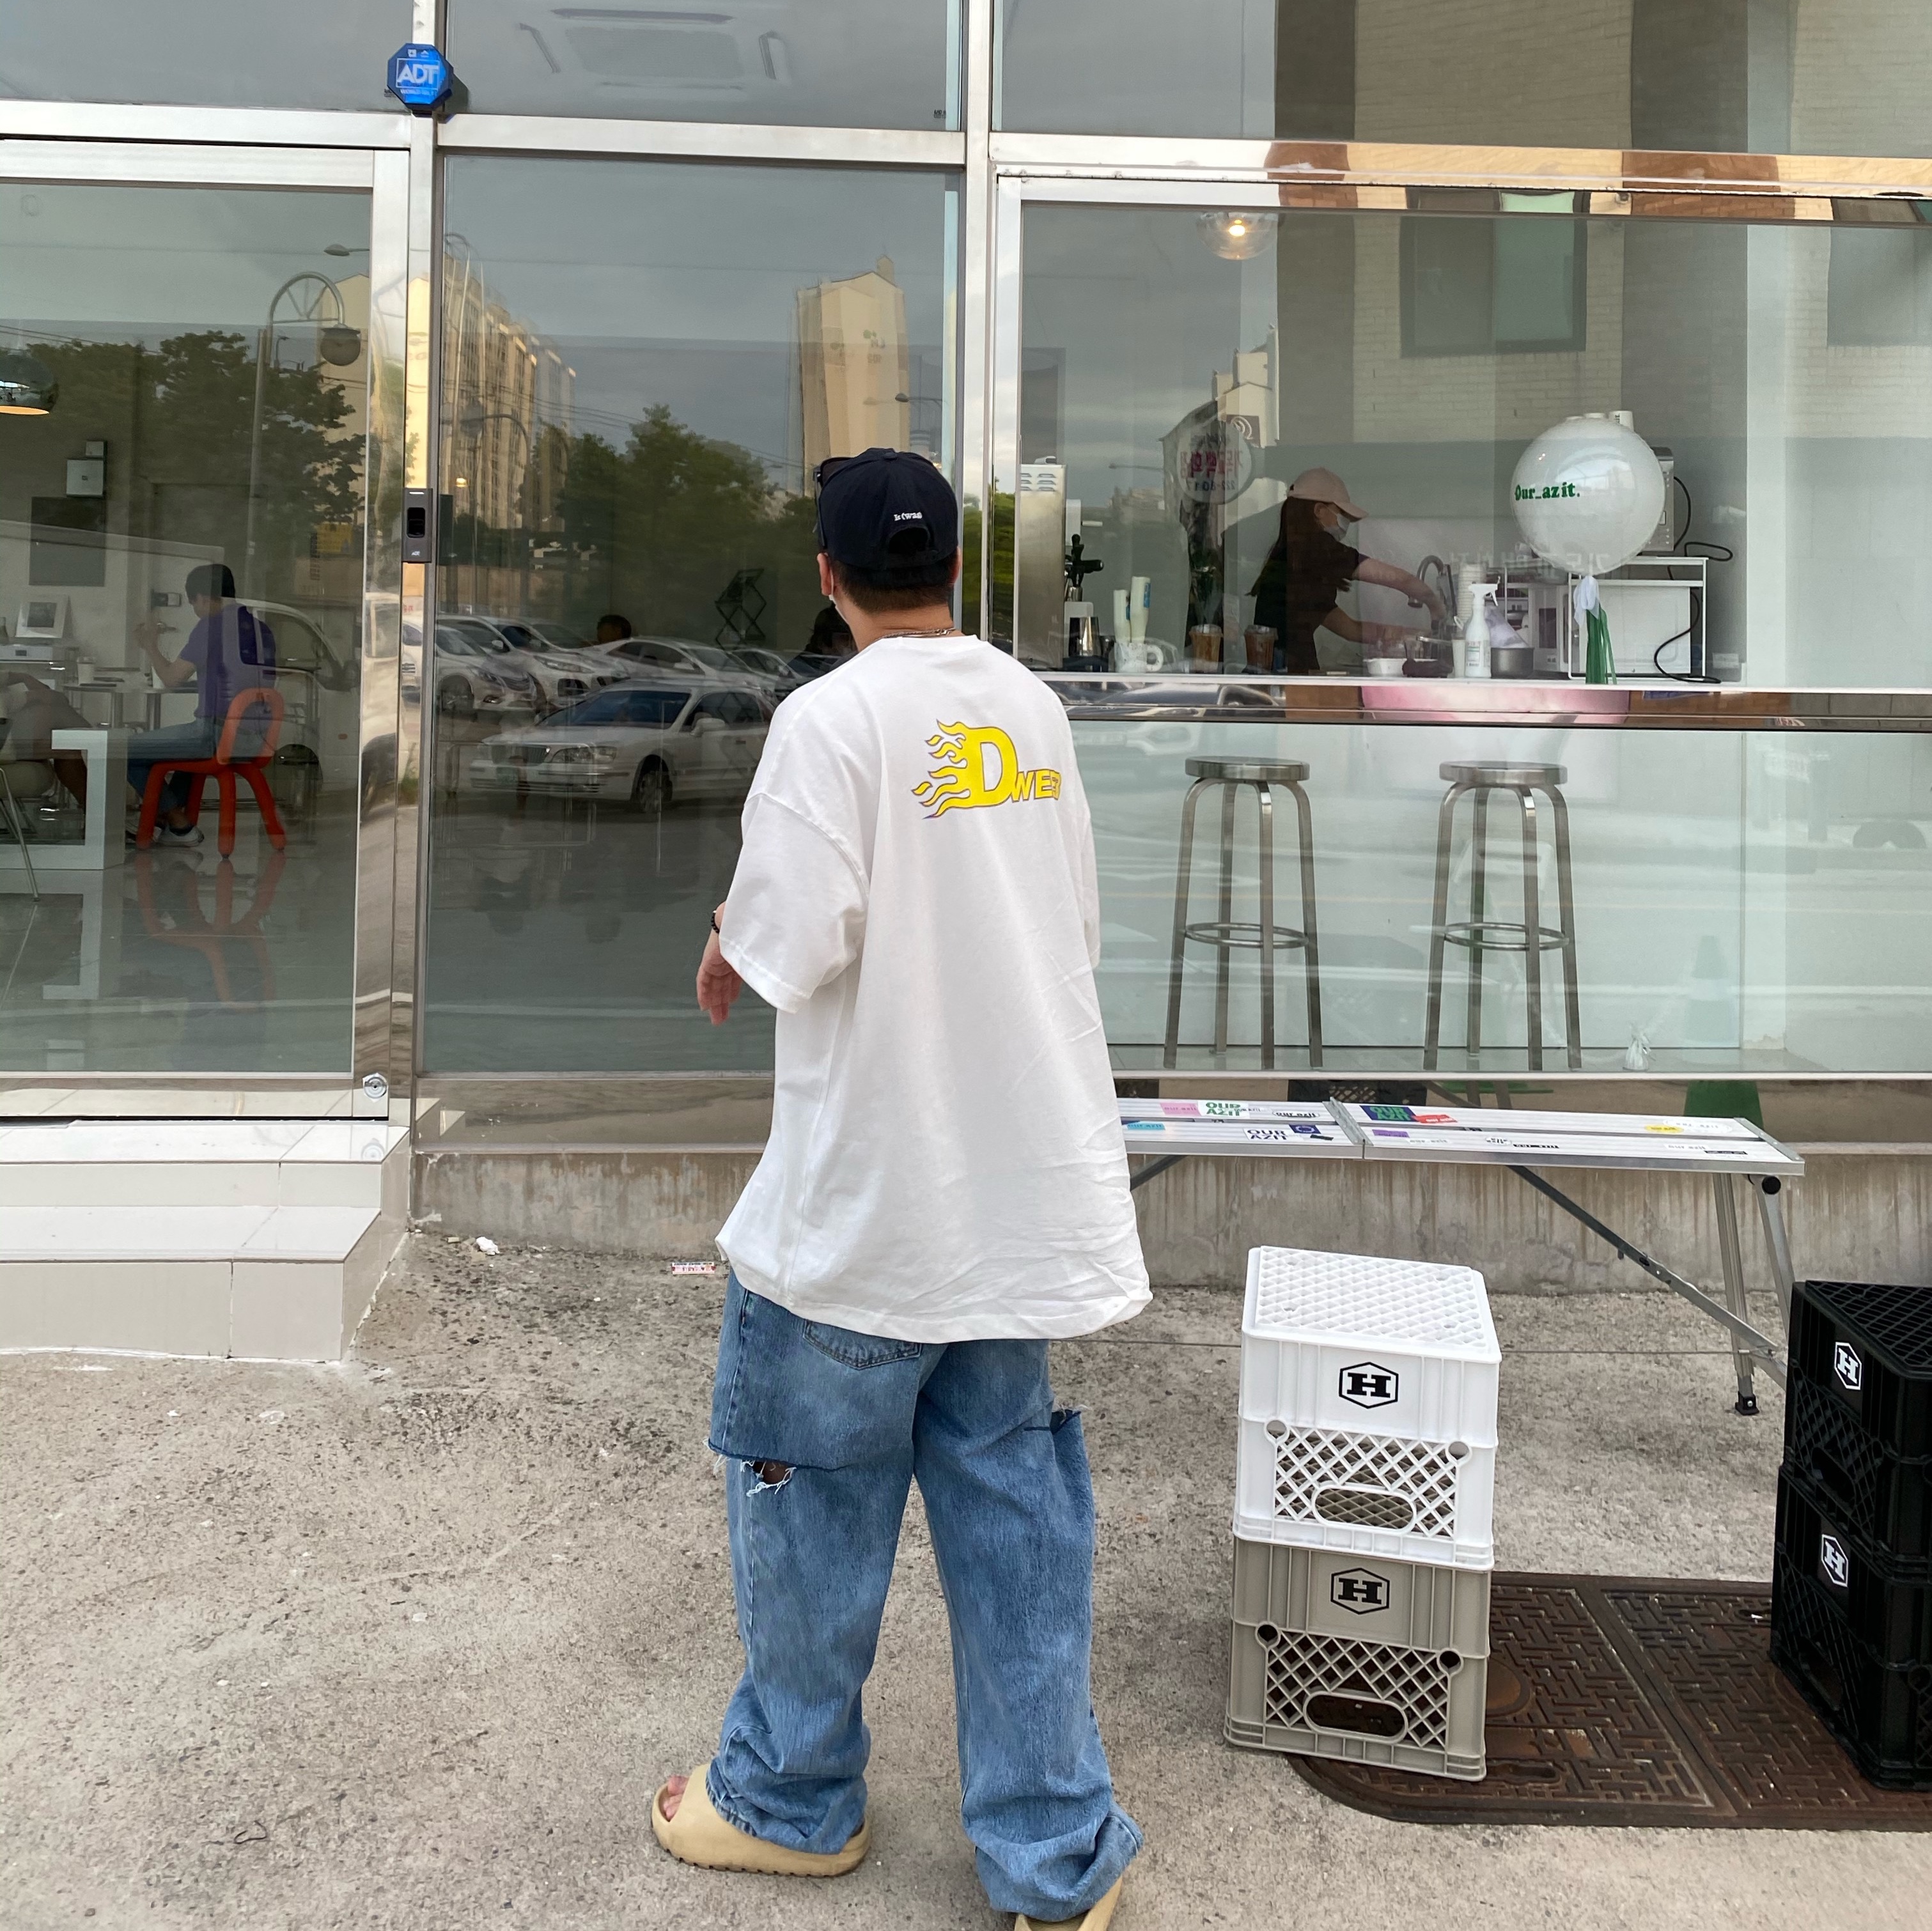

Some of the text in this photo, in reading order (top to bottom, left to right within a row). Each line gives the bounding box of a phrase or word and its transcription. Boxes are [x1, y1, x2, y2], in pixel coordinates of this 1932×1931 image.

[397, 63, 439, 84] ADT
[1837, 1347, 1858, 1384] H
[1347, 1372, 1391, 1398] H
[1823, 1540, 1845, 1580] H
[1338, 1578, 1382, 1604] H
